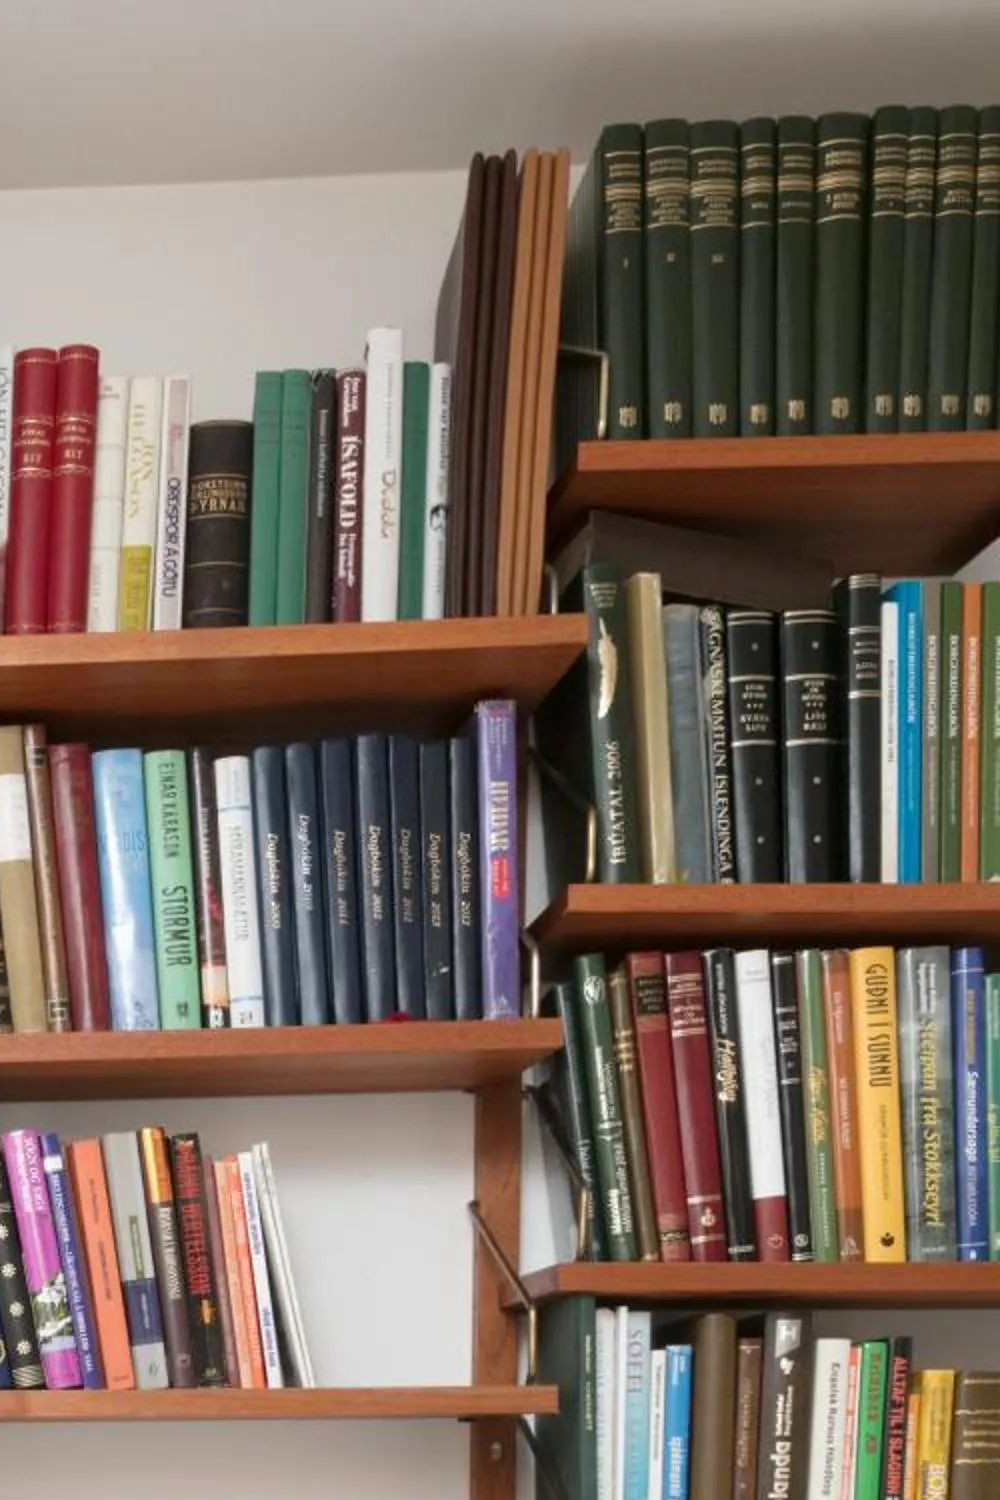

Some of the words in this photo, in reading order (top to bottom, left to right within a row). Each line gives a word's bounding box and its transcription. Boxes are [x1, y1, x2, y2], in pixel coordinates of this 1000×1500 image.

[338, 434, 361, 528] ÍSAFOLD
[158, 763, 177, 800] EINAR
[161, 884, 193, 968] STORMUR
[865, 963, 889, 1015] GUÐNI
[867, 1033, 893, 1088] SUNNU
